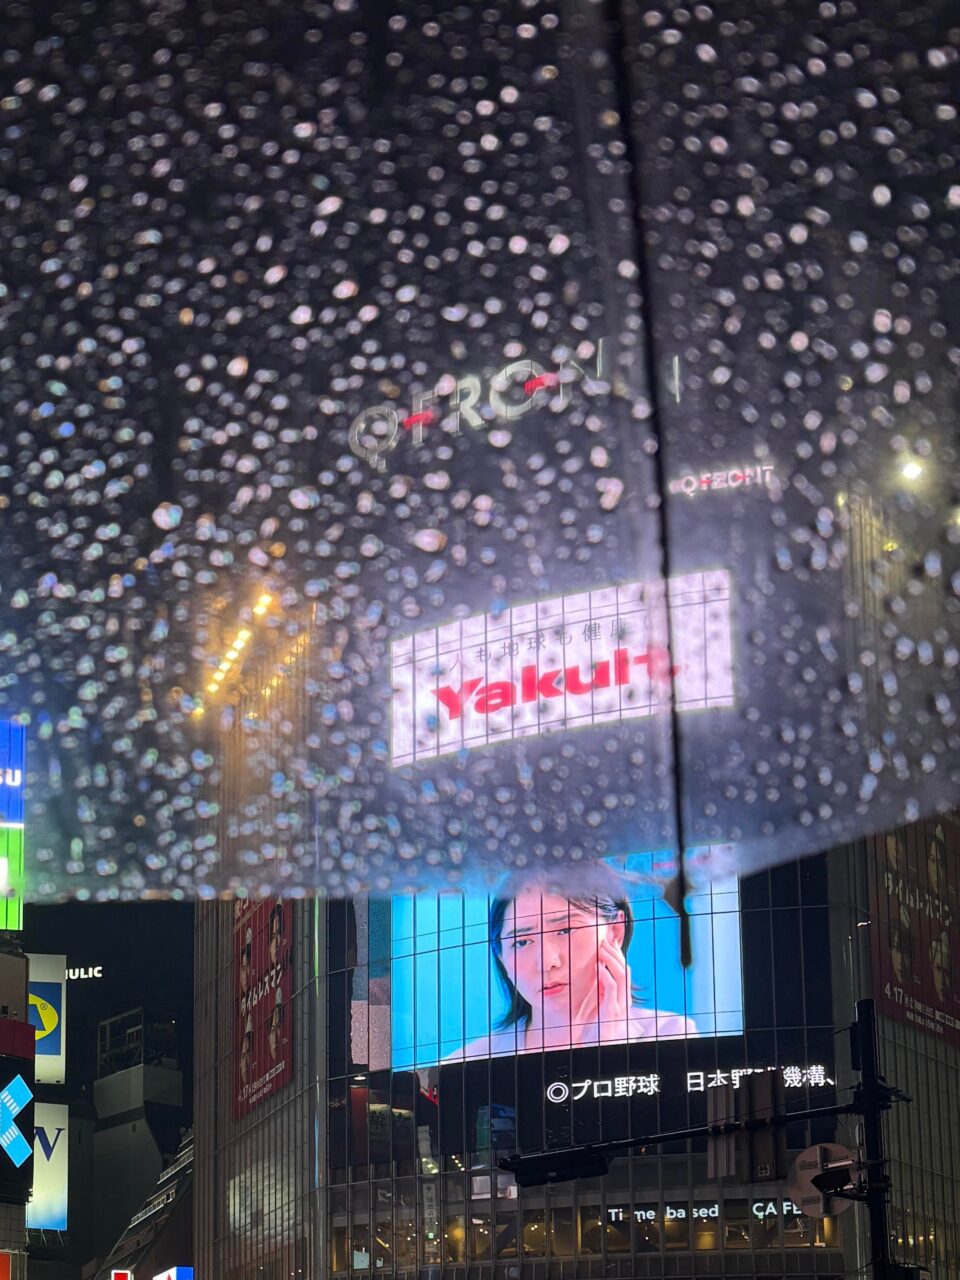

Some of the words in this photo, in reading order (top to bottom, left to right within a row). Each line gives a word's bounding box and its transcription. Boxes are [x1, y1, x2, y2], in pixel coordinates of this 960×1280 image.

[431, 647, 681, 721] Yakult
[571, 1074, 661, 1101] プロ野球
[687, 1065, 836, 1093] 日本機構、
